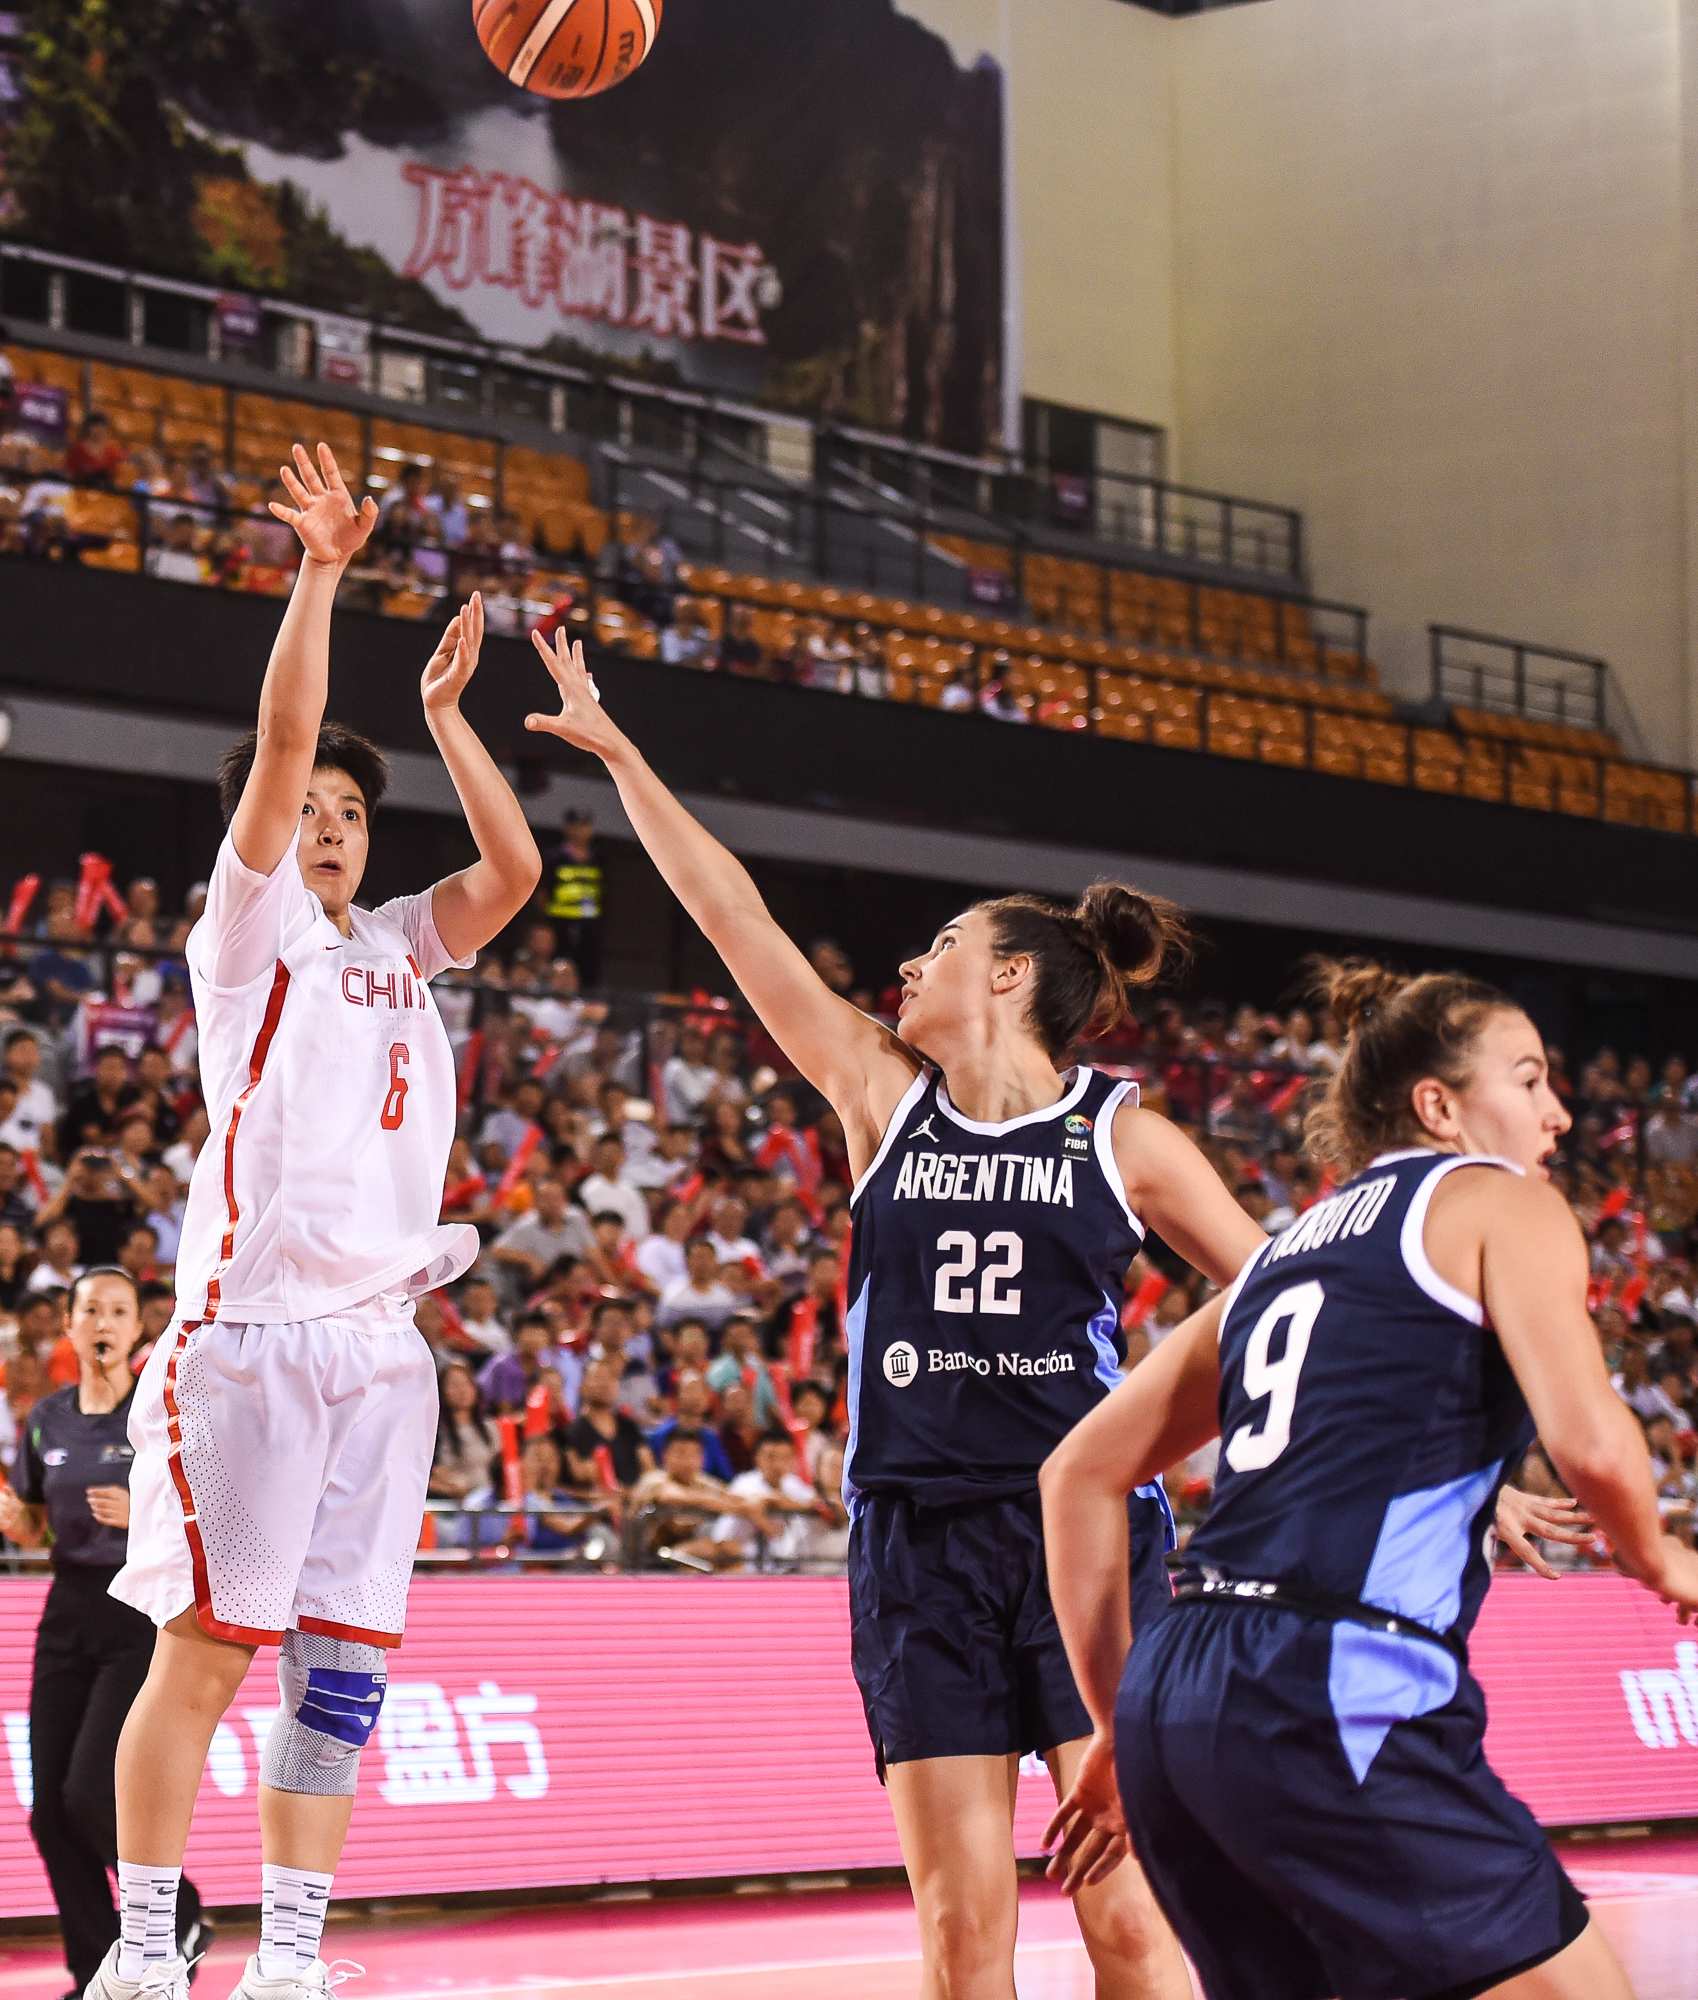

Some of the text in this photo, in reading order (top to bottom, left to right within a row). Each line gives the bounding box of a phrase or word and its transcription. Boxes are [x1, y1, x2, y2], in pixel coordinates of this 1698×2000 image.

[380, 1042, 410, 1131] 6
[1064, 1137, 1089, 1151] FIBA
[933, 1230, 1024, 1316] 22
[996, 1349, 1076, 1376] Nación
[1226, 1280, 1325, 1474] 9
